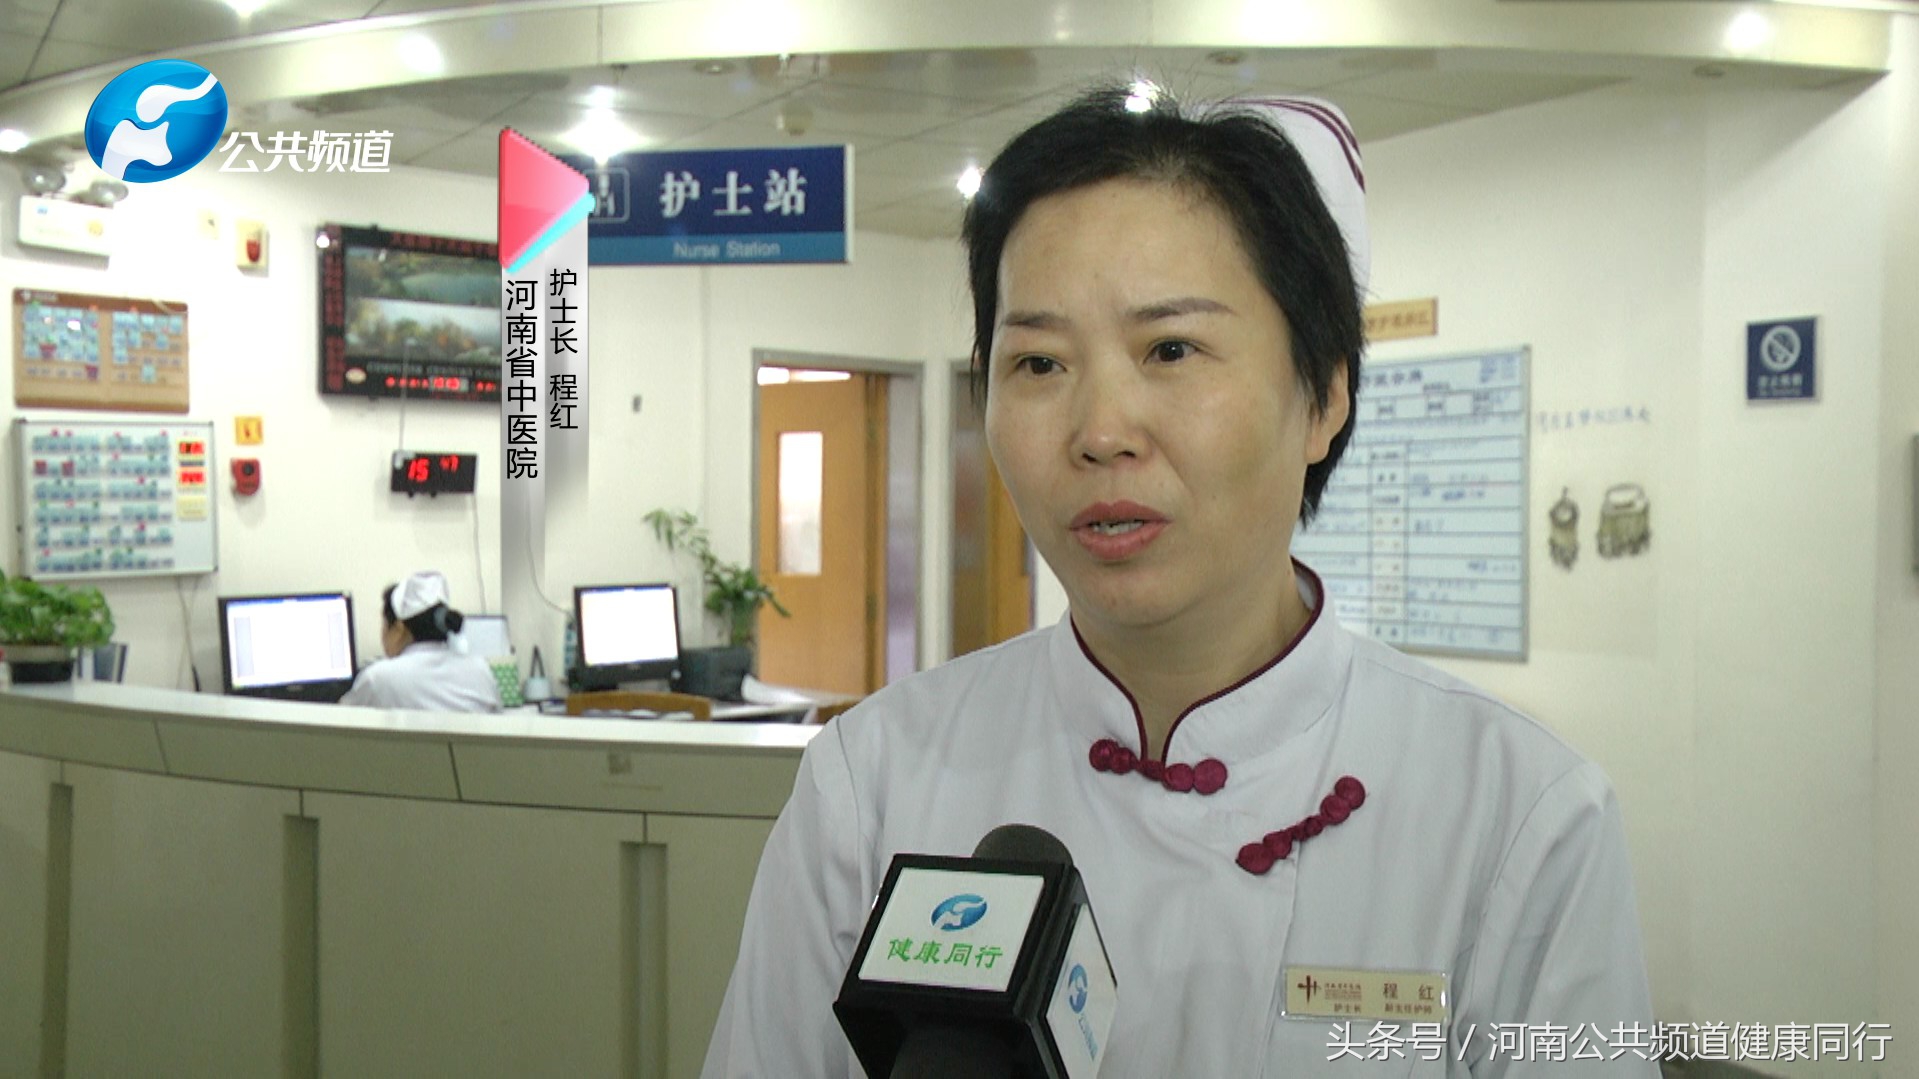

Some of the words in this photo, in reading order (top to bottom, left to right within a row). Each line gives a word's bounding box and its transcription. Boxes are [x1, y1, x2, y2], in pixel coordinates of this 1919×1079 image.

[659, 167, 807, 218] 护士站
[673, 242, 720, 258] Nurse
[726, 240, 781, 257] Station
[408, 458, 430, 482] 15
[887, 938, 1003, 969] 健康同行
